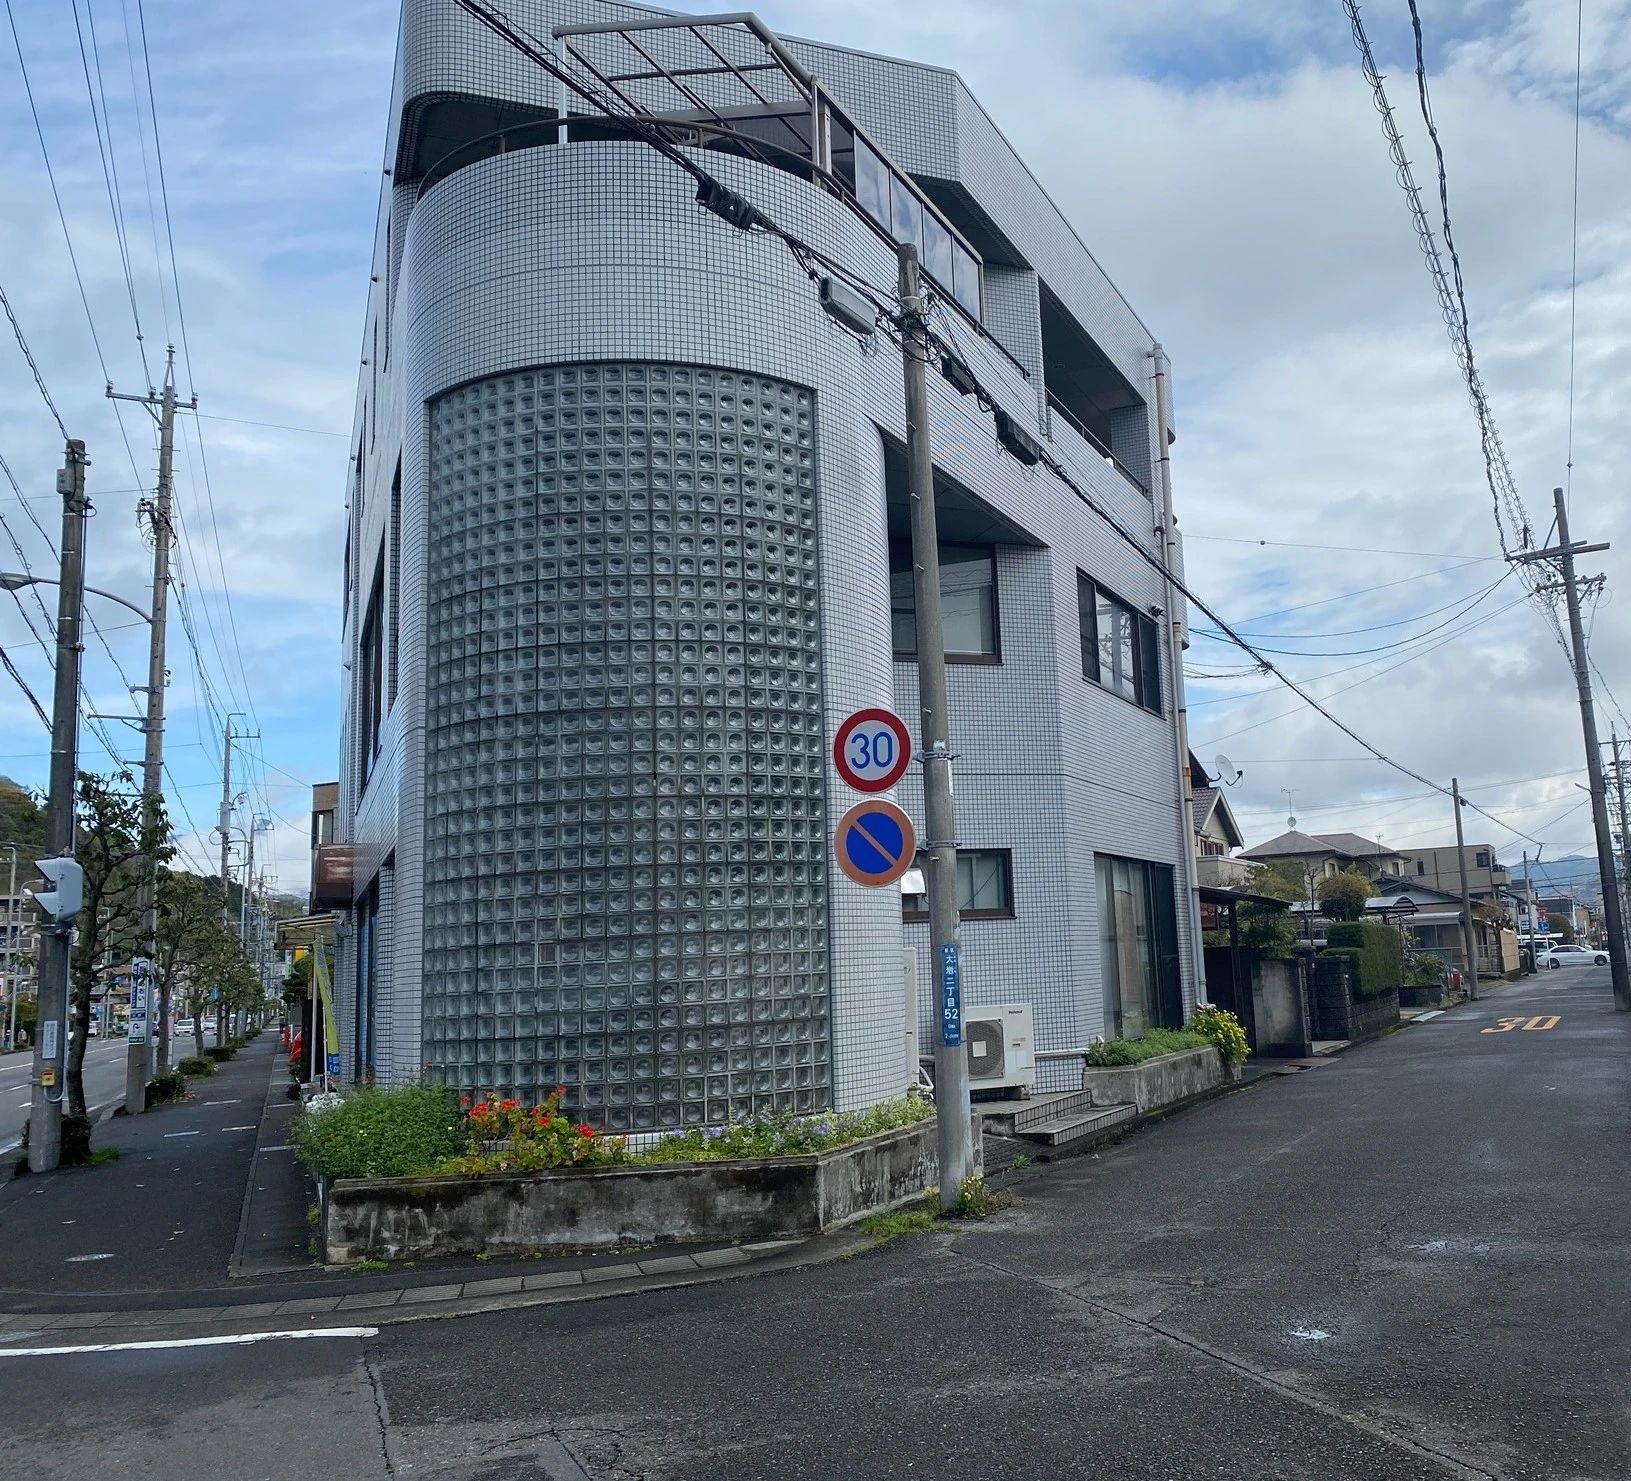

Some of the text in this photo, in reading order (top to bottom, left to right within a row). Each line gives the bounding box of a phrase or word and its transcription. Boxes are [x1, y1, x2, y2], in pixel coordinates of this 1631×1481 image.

[851, 731, 893, 770] 30
[944, 1008, 959, 1020] 52
[1480, 1015, 1562, 1034] 30
